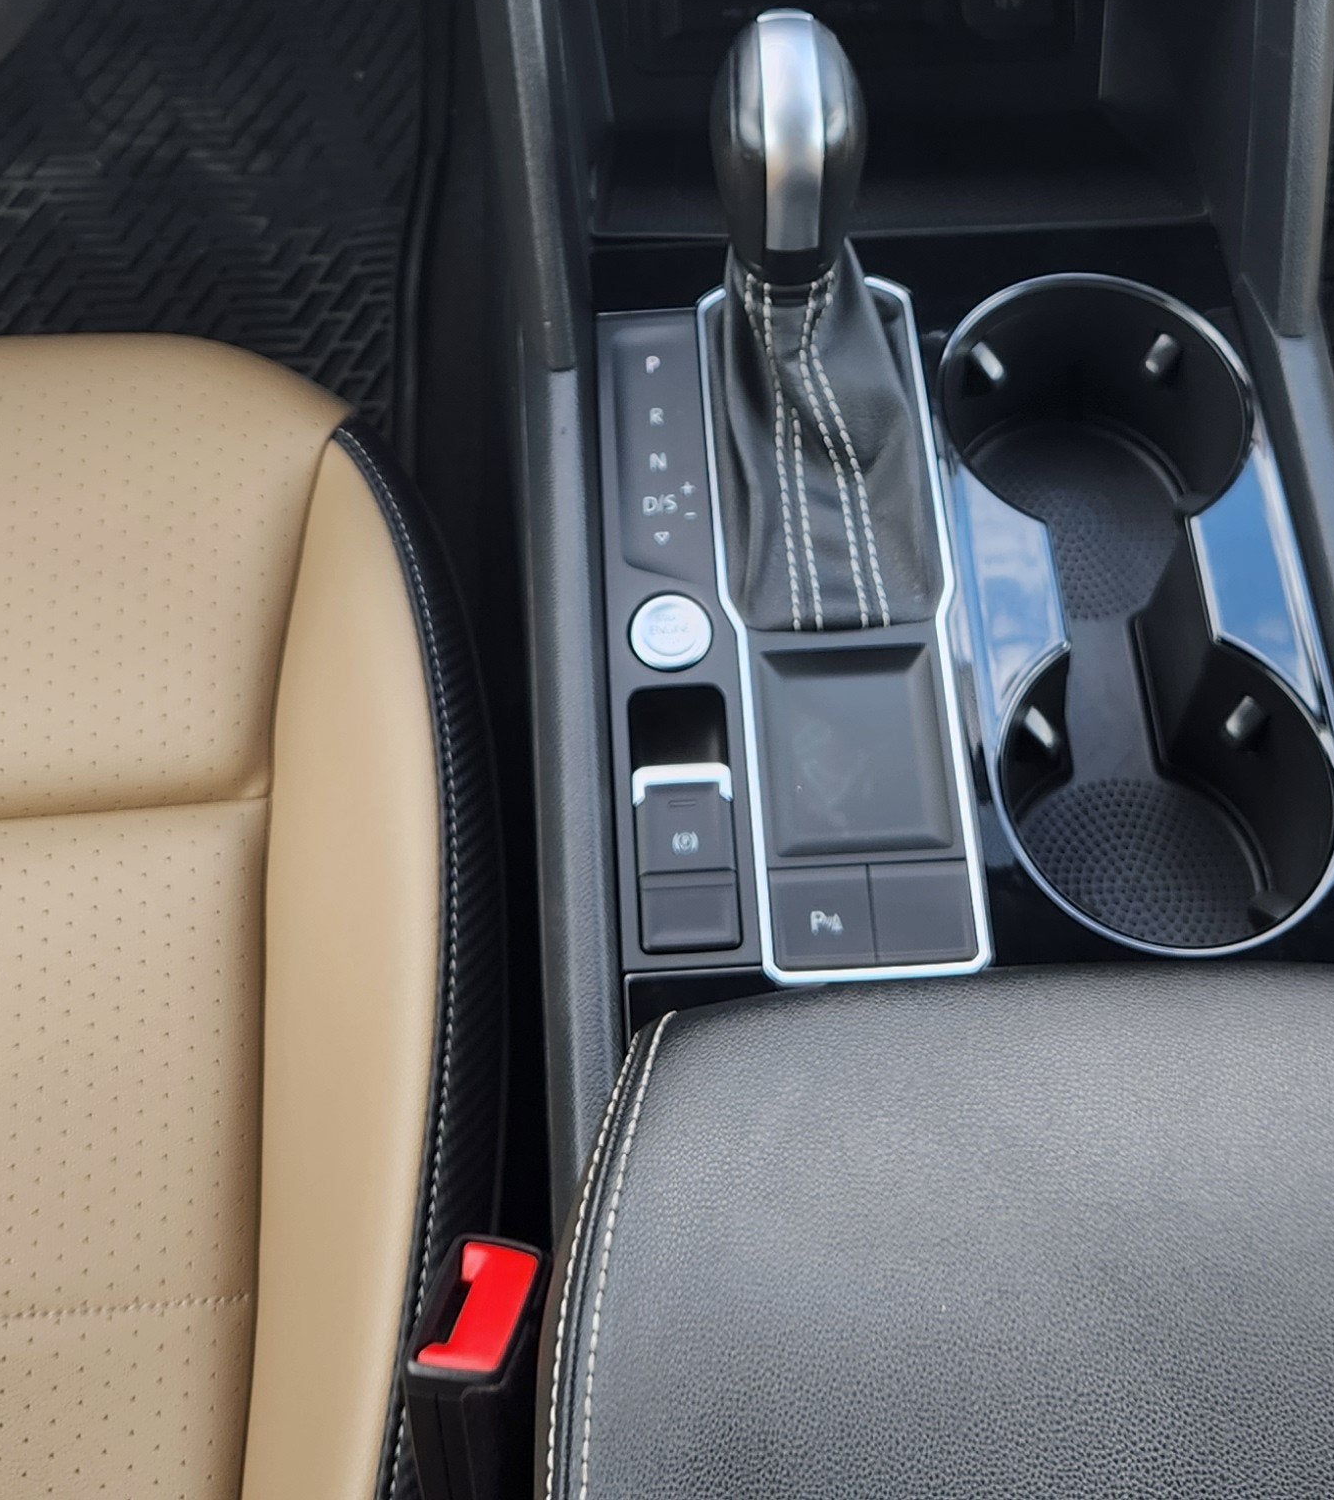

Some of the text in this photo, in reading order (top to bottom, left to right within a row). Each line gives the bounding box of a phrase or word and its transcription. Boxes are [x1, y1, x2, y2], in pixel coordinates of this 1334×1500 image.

[645, 354, 661, 374] P
[649, 407, 665, 427] R
[649, 451, 667, 472] N
[642, 493, 678, 517] D/S
